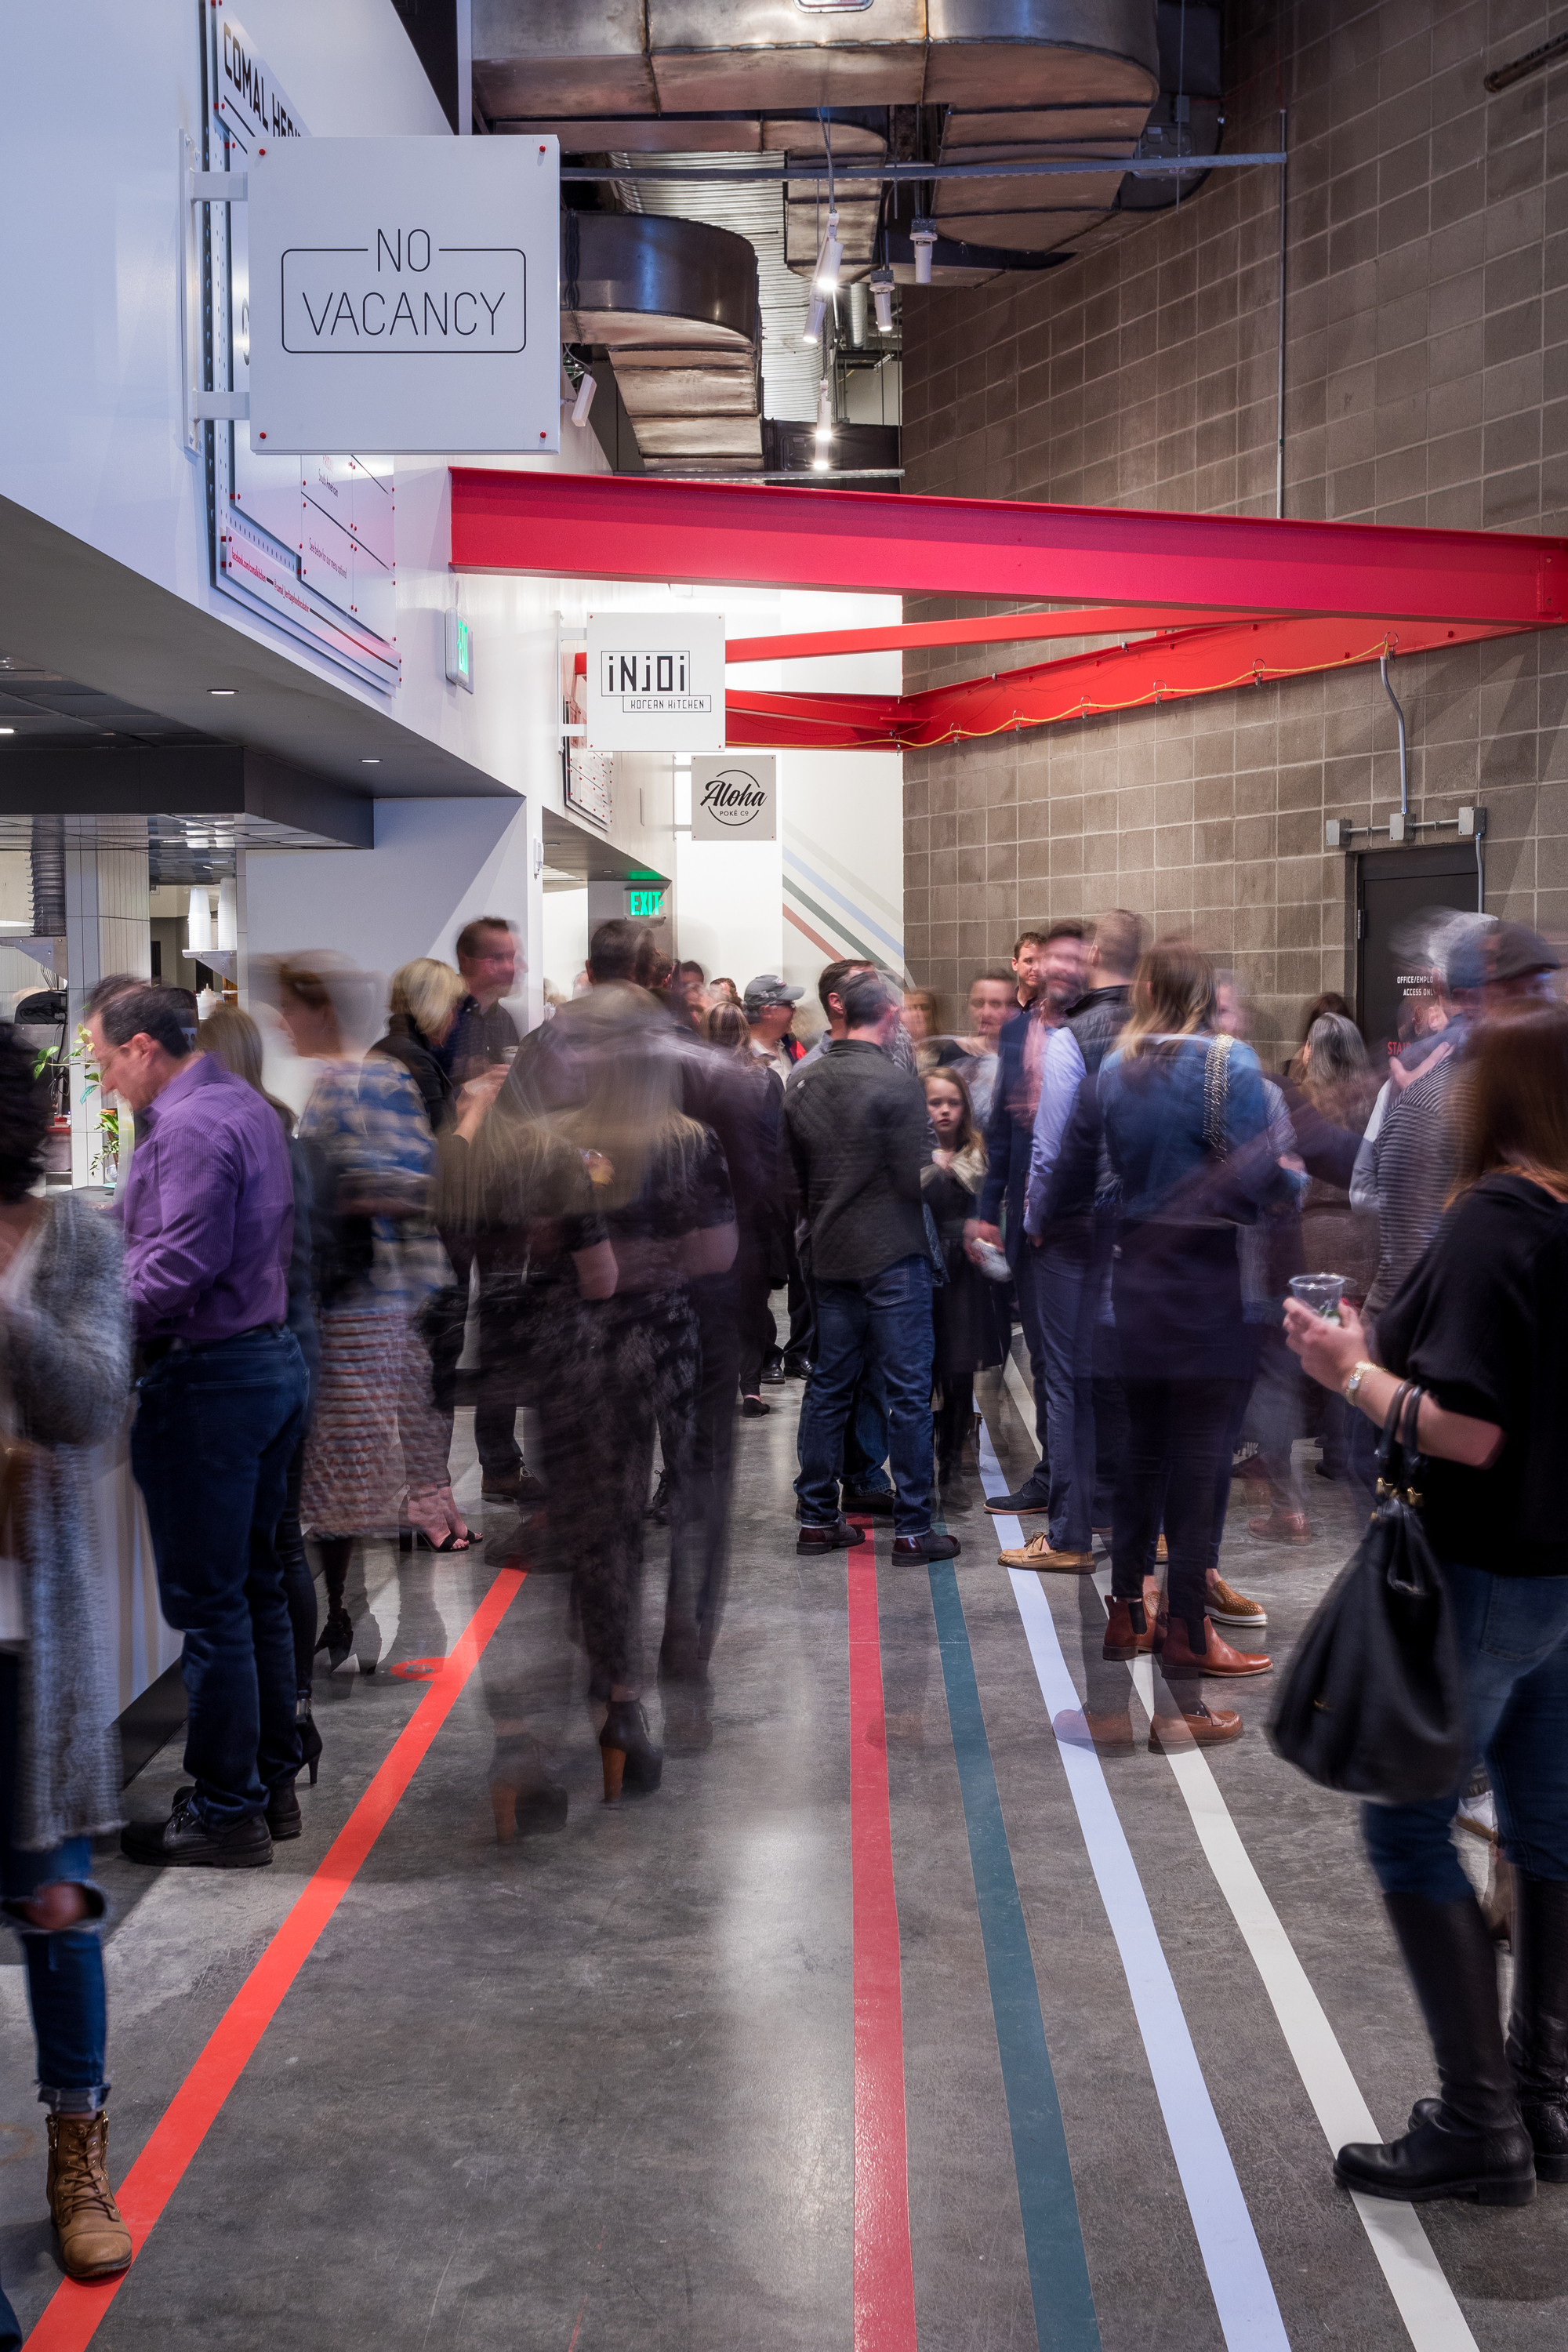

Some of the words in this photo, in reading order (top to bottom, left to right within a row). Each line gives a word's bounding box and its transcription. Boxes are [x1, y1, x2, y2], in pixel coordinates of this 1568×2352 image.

[223, 22, 268, 132] COMAL
[377, 228, 430, 273] NO
[302, 292, 506, 336] VACANCY
[699, 780, 768, 807] Aloha
[630, 891, 661, 916] EXIT
[1403, 988, 1422, 996] ACCESS
